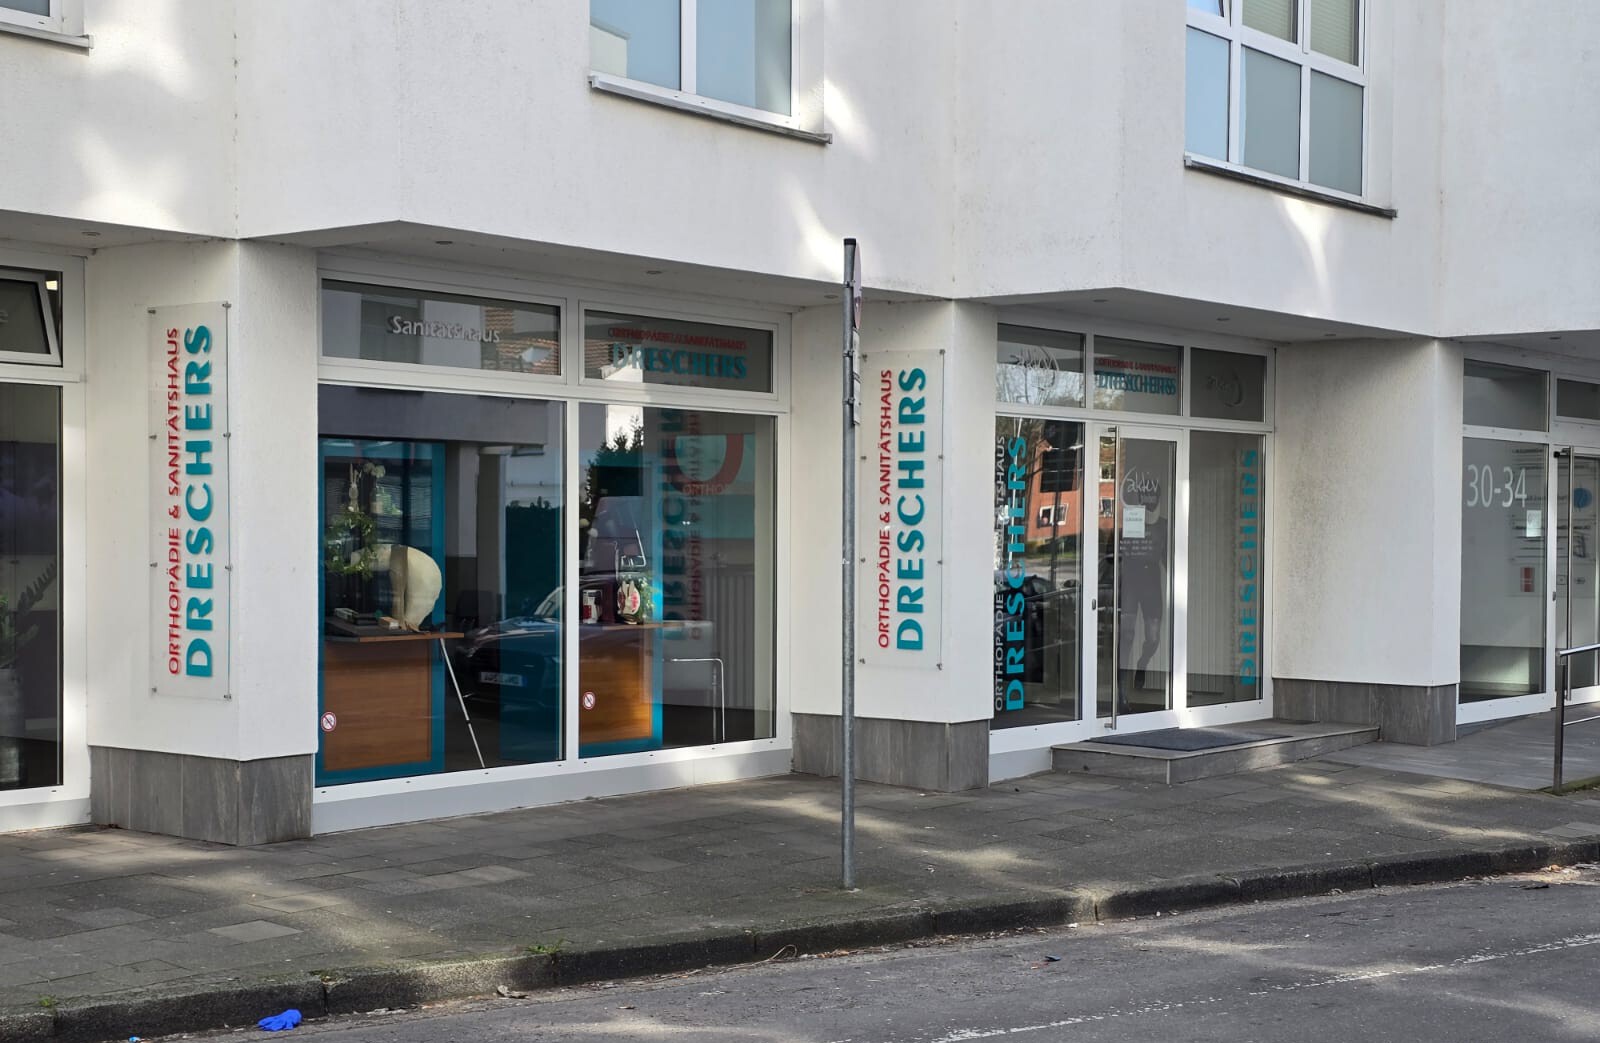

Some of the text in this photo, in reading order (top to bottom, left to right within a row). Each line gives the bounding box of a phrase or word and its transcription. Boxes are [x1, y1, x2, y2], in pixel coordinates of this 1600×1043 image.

[612, 341, 748, 380] DRESCHERS
[1466, 464, 1528, 508] 30-34
[167, 328, 181, 675] ORTHOPÄDIE & SANITÄTSHAUS
[185, 325, 214, 678] DRESCHERS
[878, 370, 892, 648] ORTHOPÄDIE & SANITÄTSHAUS
[896, 368, 927, 651] DRESCHERS
[1005, 437, 1027, 712] DRESCHERS
[1240, 449, 1258, 686] DRESCHERS
